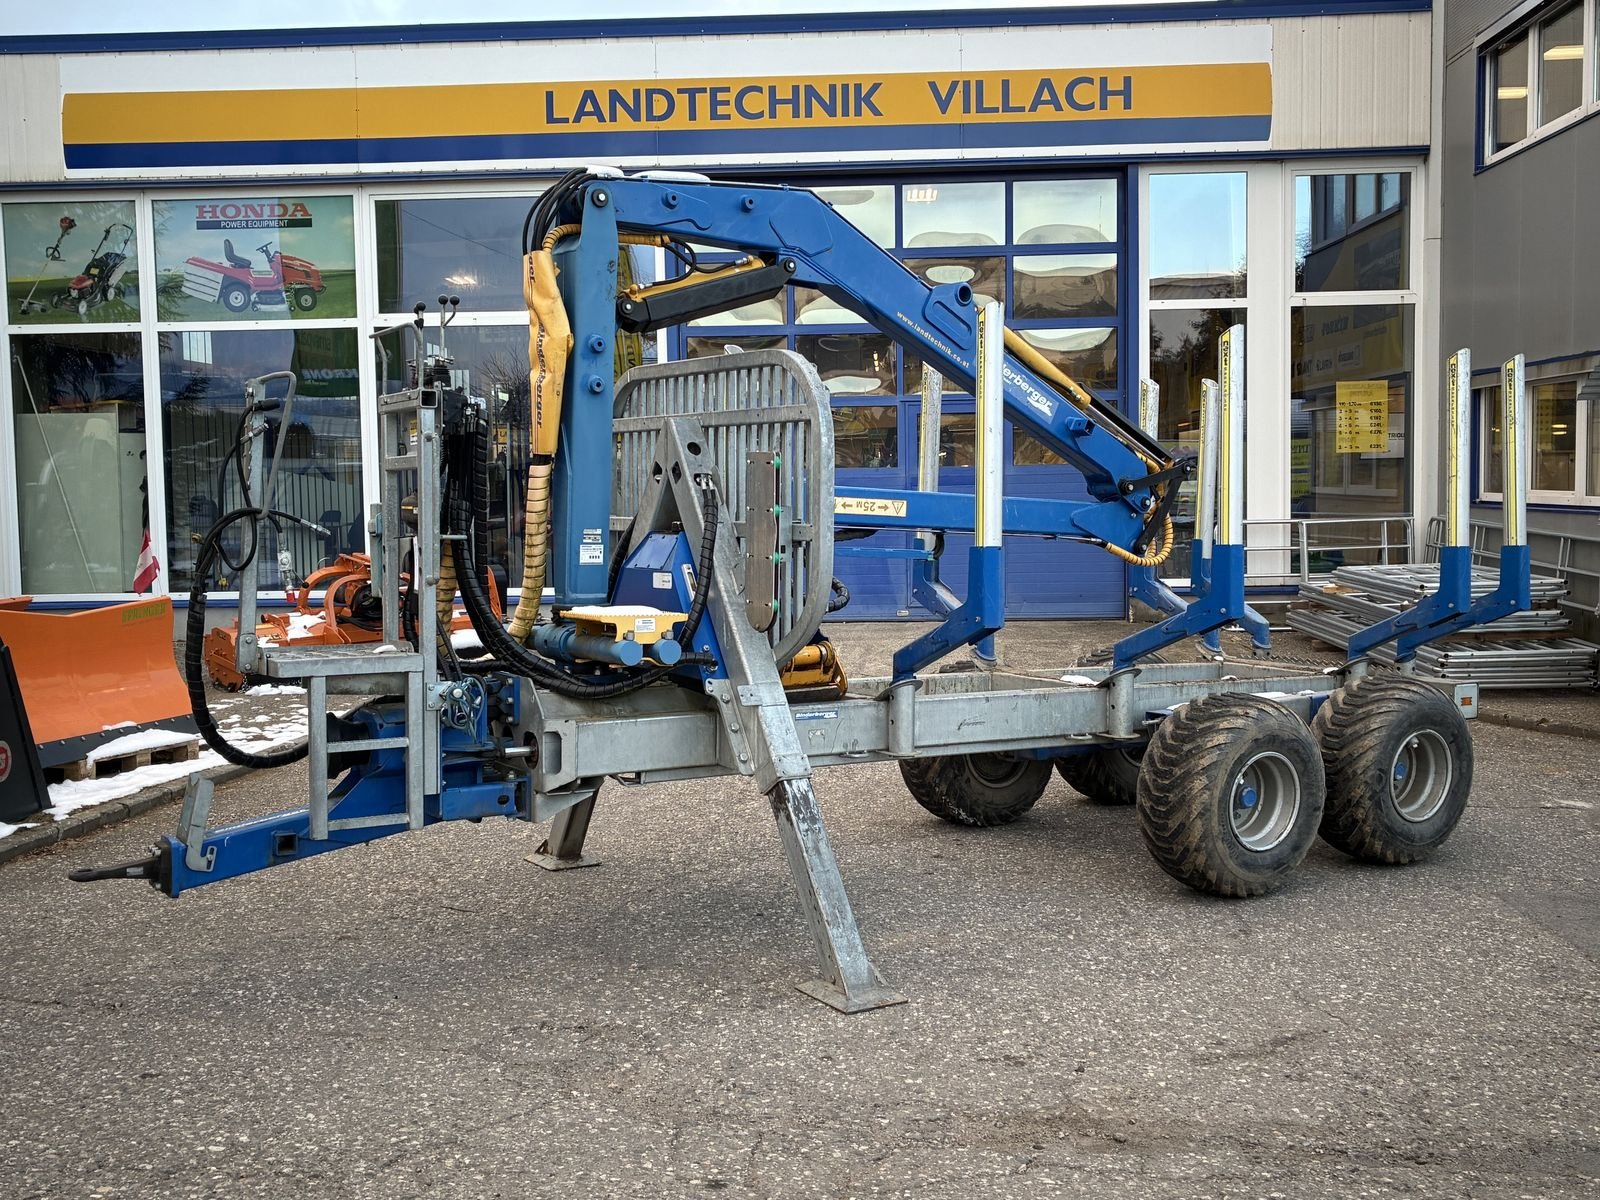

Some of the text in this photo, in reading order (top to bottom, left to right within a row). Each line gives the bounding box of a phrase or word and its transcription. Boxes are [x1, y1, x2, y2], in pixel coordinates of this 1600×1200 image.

[545, 75, 1133, 126] LANDTECHNIK VILLACH
[195, 202, 312, 219] HONDA
[221, 219, 289, 228] POWER EQUIPMENT
[896, 311, 970, 369] www.landtechnik.co.at
[1003, 363, 1053, 408] erberger
